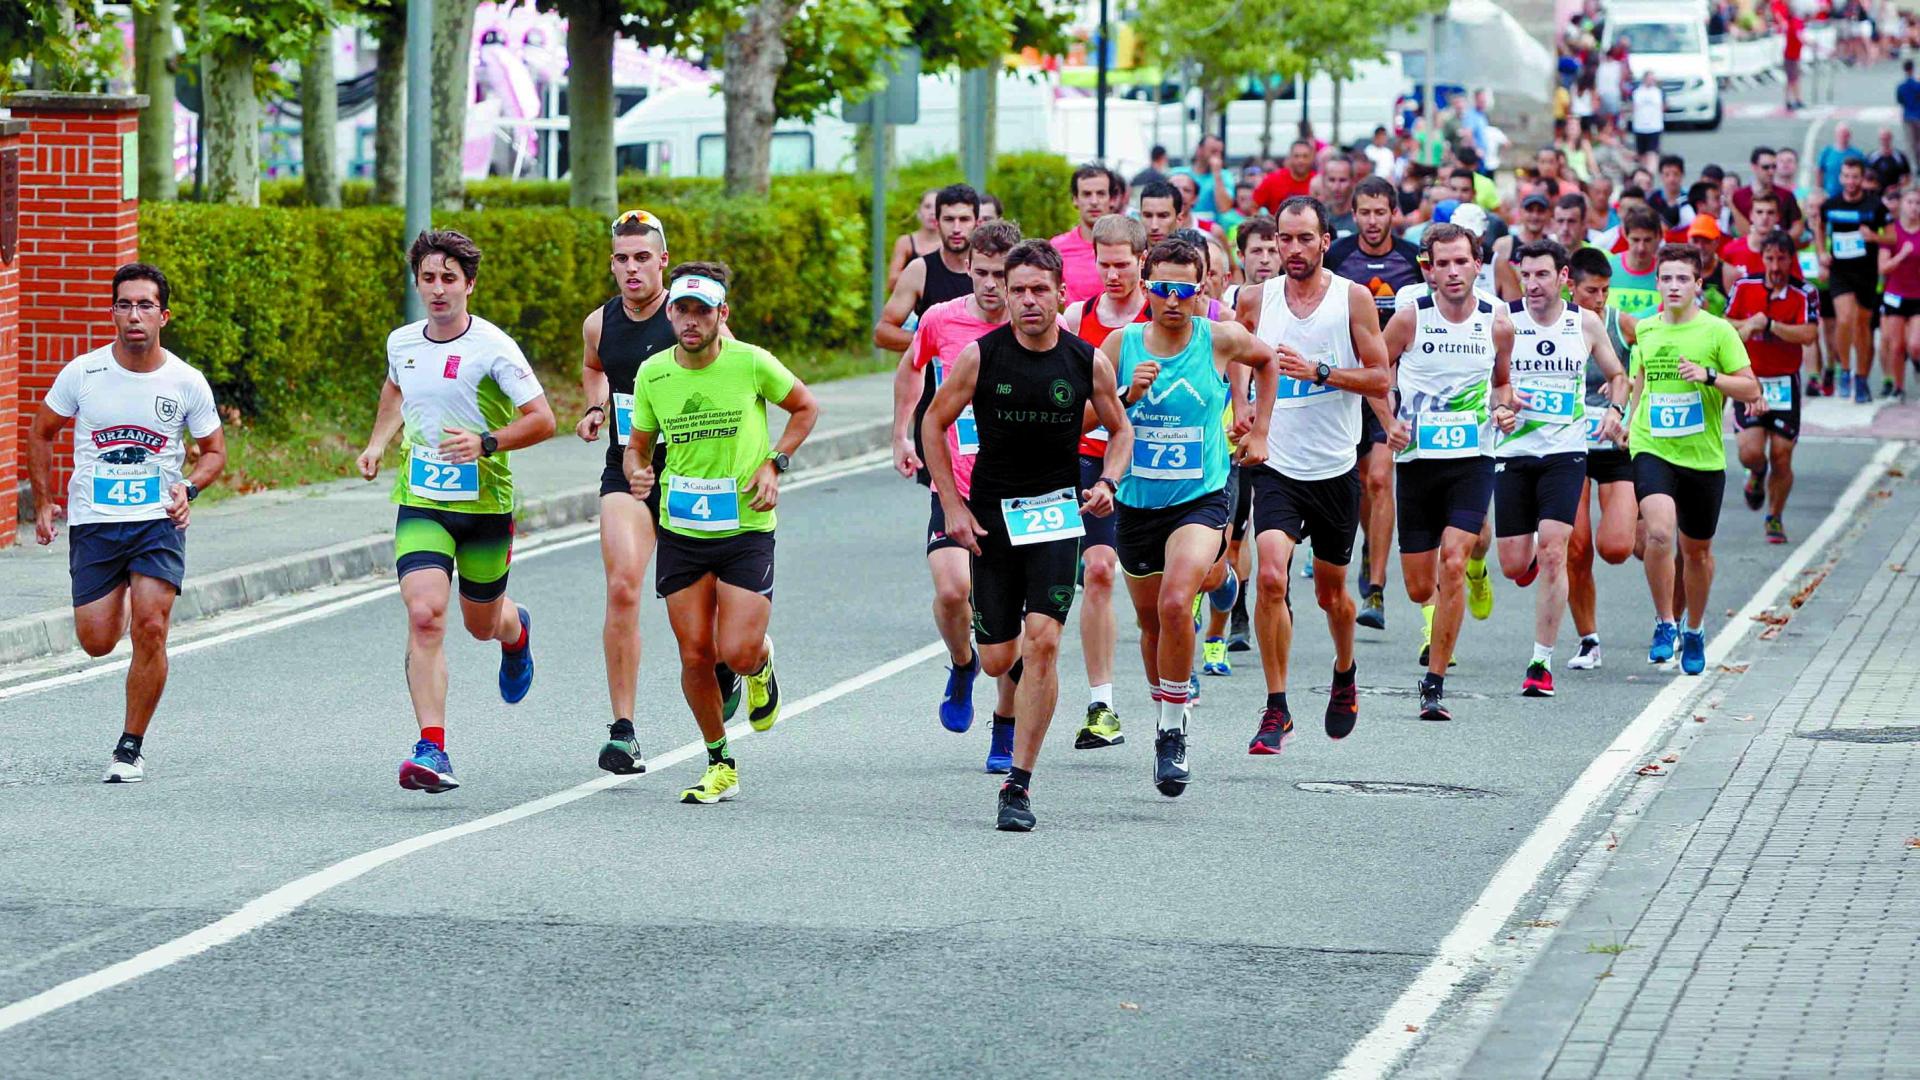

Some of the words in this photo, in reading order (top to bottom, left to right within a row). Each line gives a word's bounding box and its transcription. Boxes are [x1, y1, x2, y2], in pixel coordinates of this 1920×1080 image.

[1531, 390, 1563, 413] 63
[1660, 406, 1690, 427] 67
[96, 428, 162, 447] URZANTE
[1431, 426, 1466, 448] 49
[1147, 443, 1187, 468] 73
[423, 463, 462, 489] 22
[107, 480, 147, 504] 45
[691, 495, 712, 520] 4
[1023, 506, 1065, 532] 29
